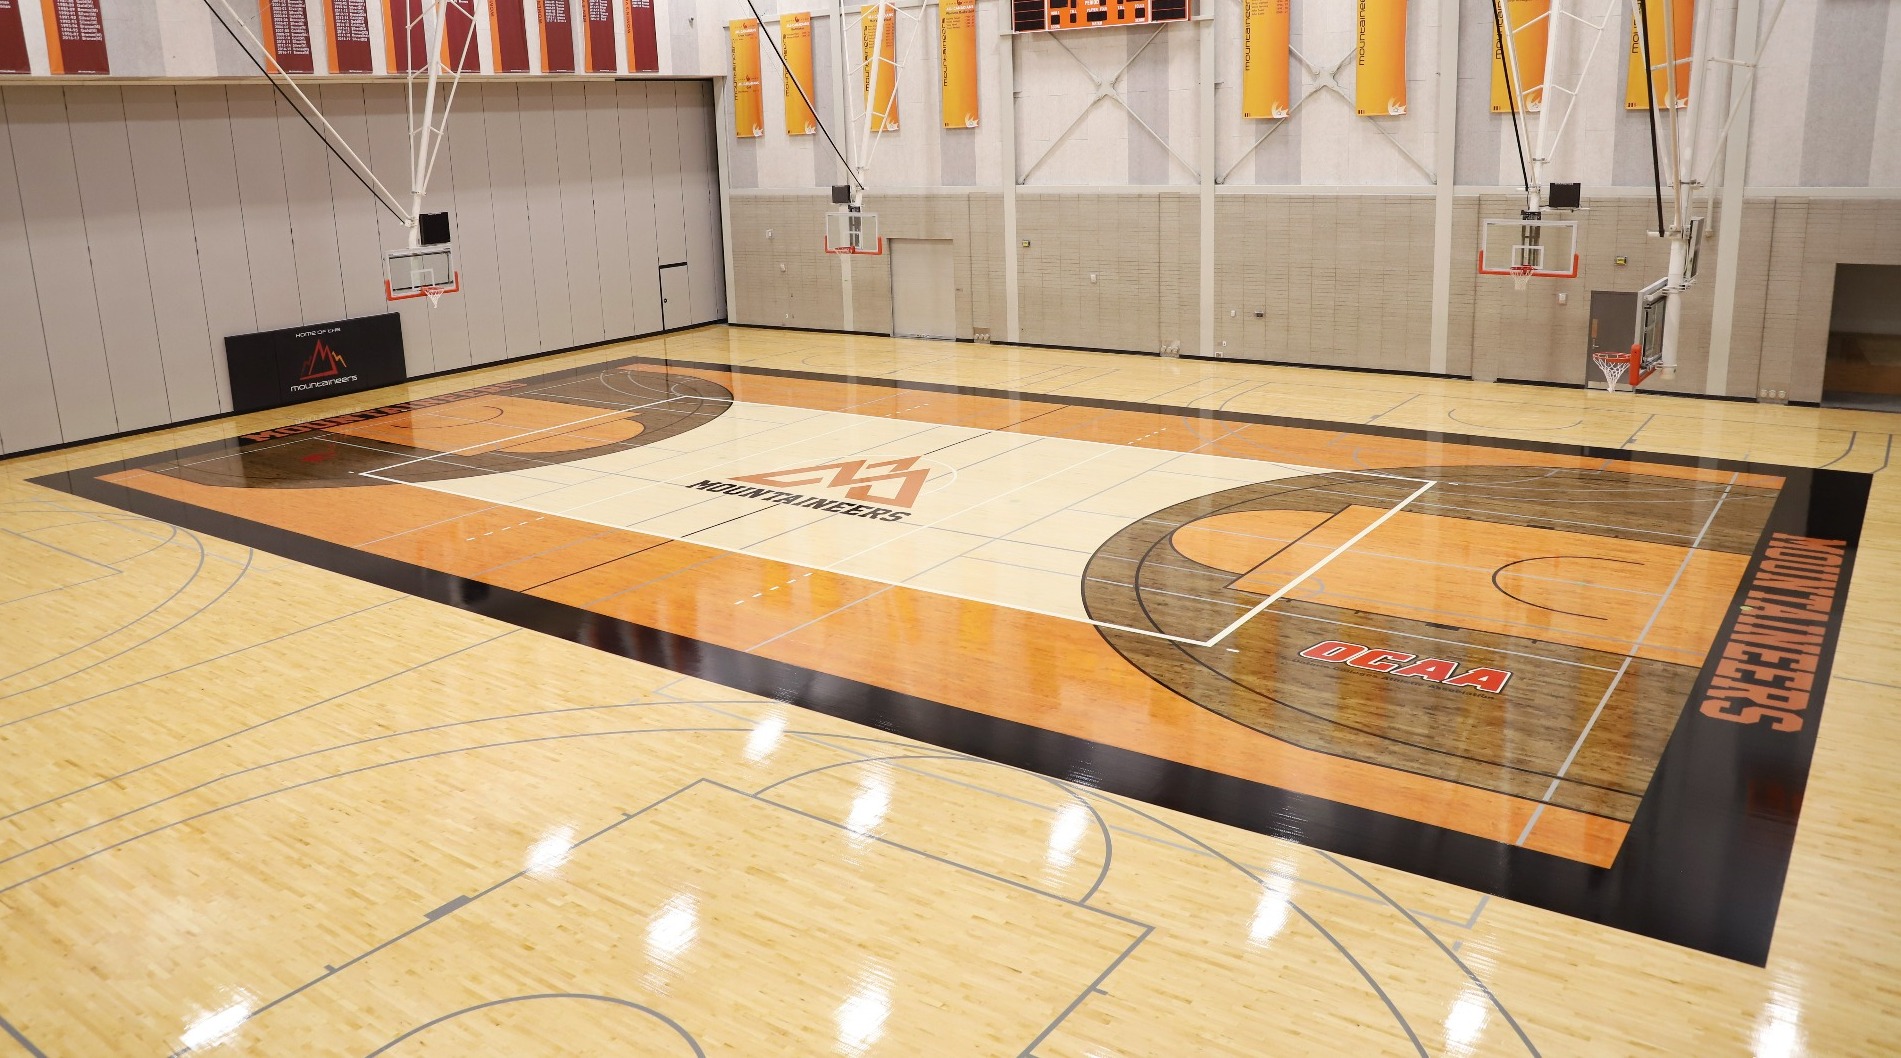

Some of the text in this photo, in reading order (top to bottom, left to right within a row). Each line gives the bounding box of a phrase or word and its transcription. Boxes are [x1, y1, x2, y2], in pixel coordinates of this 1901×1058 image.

[685, 479, 912, 522] MOUNTAINEERS
[1699, 532, 1848, 733] MOUNTAINEERS
[1298, 640, 1514, 695] OCAA
